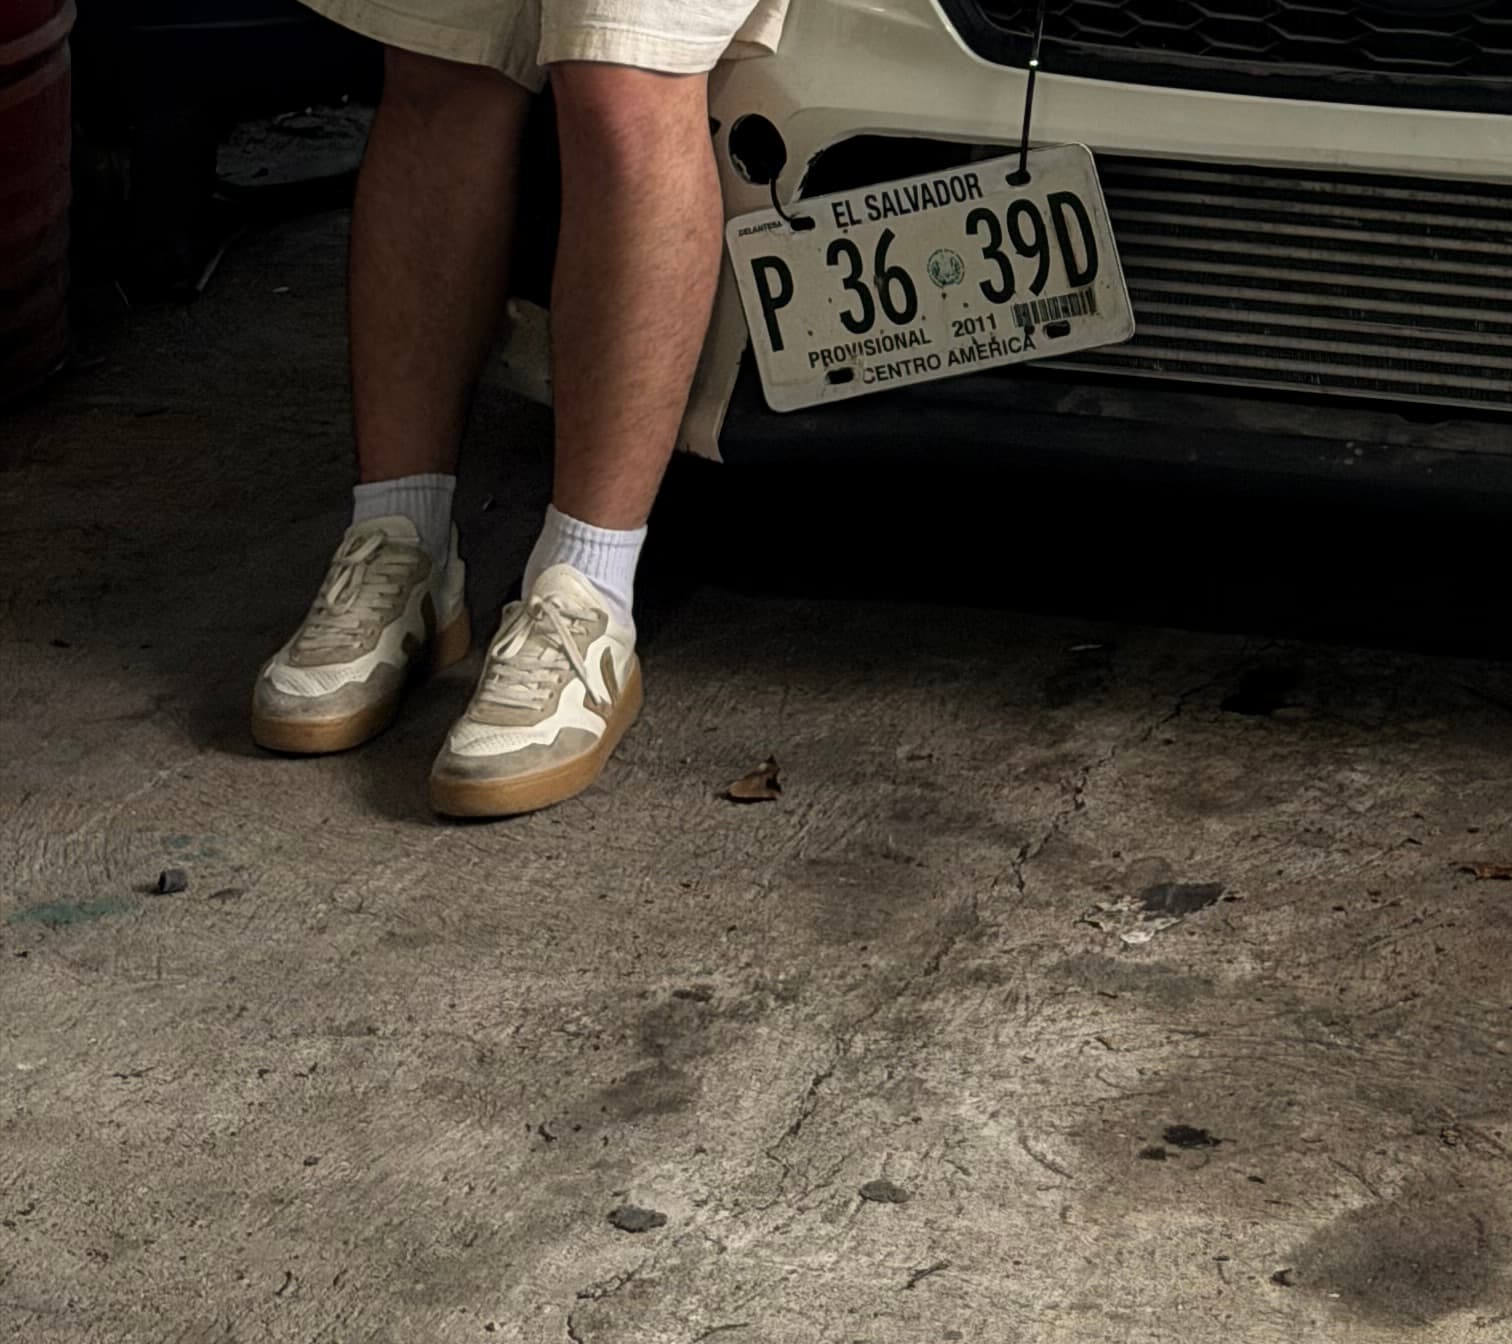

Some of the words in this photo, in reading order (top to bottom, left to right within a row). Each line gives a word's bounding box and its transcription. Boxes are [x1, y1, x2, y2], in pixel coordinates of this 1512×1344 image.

[831, 199, 862, 229] EL
[867, 172, 984, 221] SALVADOR
[751, 255, 794, 353] P
[826, 228, 919, 335] 36
[965, 190, 1099, 305] 39D
[808, 328, 932, 369] PROVISIONAL
[951, 314, 998, 339] 2011
[862, 353, 942, 384] CENTRO
